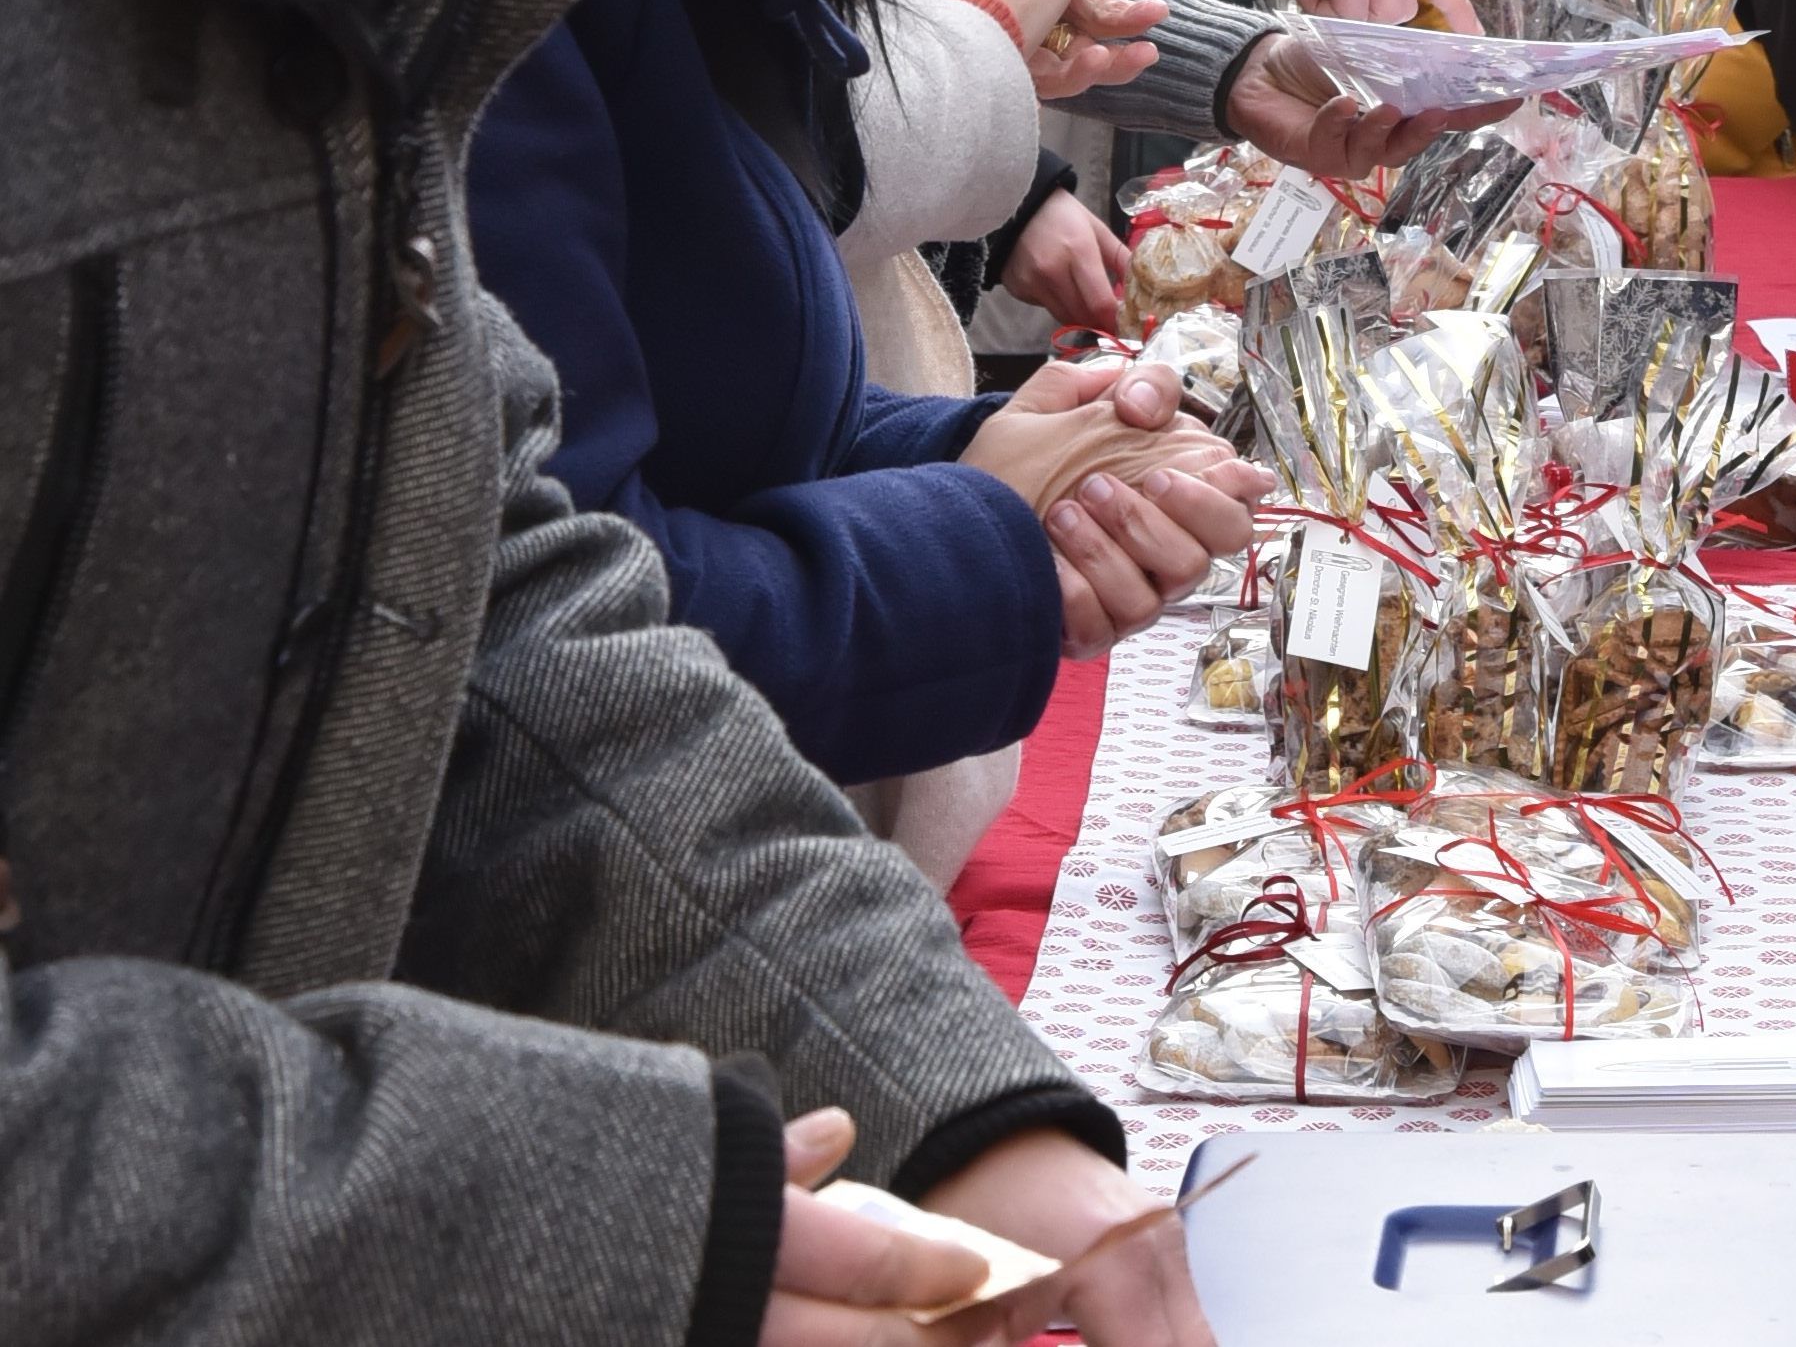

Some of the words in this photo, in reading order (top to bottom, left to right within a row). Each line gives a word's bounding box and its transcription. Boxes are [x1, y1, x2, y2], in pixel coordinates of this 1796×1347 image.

[1312, 565, 1324, 596] Domchor
[1336, 570, 1350, 607] Gesegnete
[1309, 597, 1320, 607] St.
[1304, 609, 1317, 639] Nikolaus
[1329, 609, 1345, 657] Weihnachten
